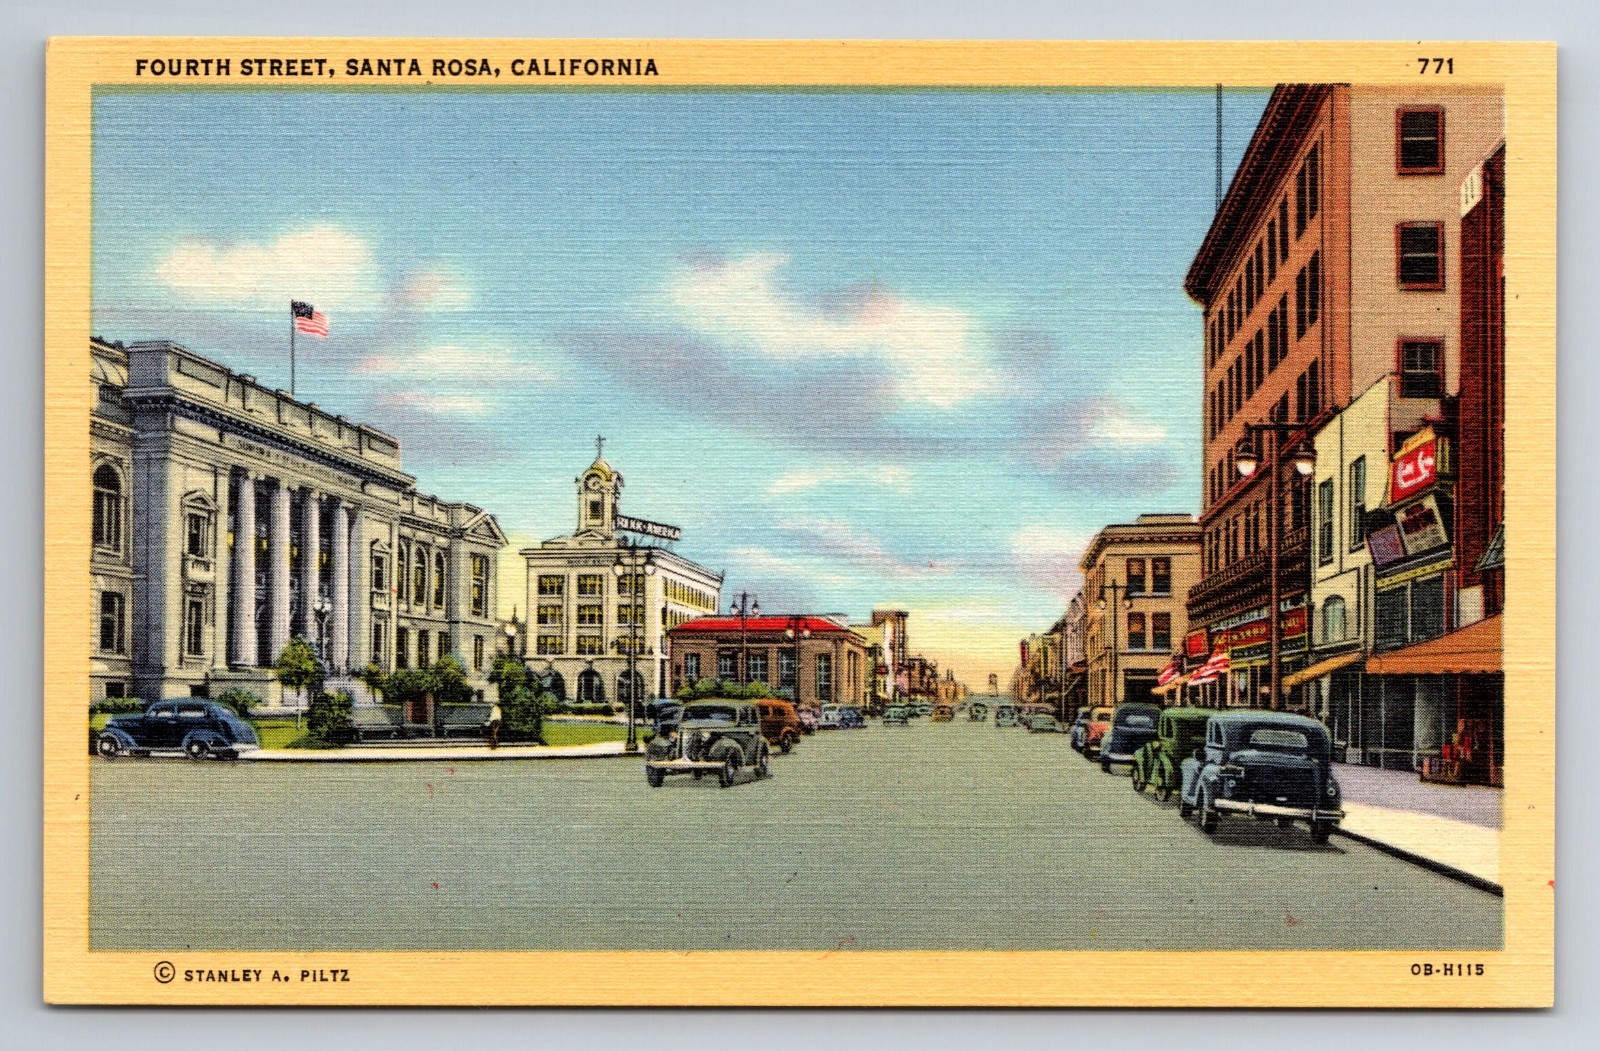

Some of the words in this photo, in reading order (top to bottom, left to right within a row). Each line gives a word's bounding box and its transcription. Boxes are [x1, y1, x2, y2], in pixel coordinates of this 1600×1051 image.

[136, 59, 230, 75] FOURTH
[241, 59, 334, 77] STREET,
[345, 59, 421, 75] SANTA
[433, 59, 500, 77] ROSA,
[511, 59, 658, 76] CALIFORNIA
[1418, 58, 1454, 74] 771
[184, 969, 262, 982] STANLEY
[272, 969, 290, 982] A.
[301, 969, 350, 982] PILTZ
[1411, 963, 1484, 976] OB-H115
